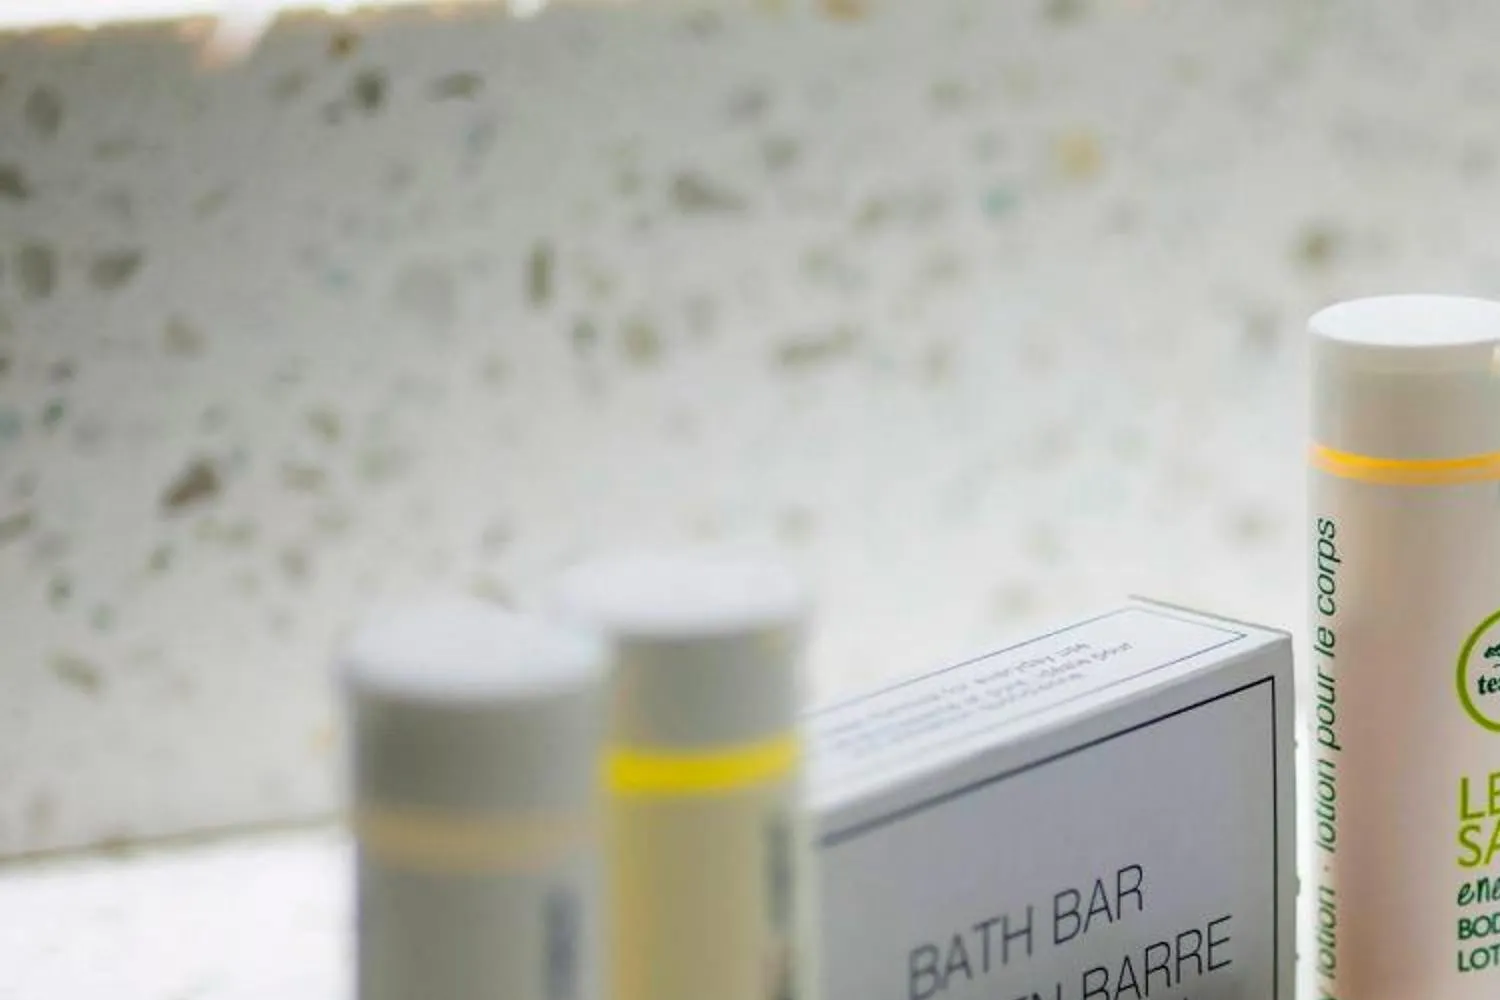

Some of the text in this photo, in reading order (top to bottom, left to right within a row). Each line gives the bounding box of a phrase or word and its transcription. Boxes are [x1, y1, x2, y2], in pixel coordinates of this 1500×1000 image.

[1315, 518, 1342, 617] corps
[1312, 626, 1335, 658] le
[1316, 664, 1342, 752] pour
[1314, 759, 1337, 854] lotion
[1052, 863, 1145, 945] BAR
